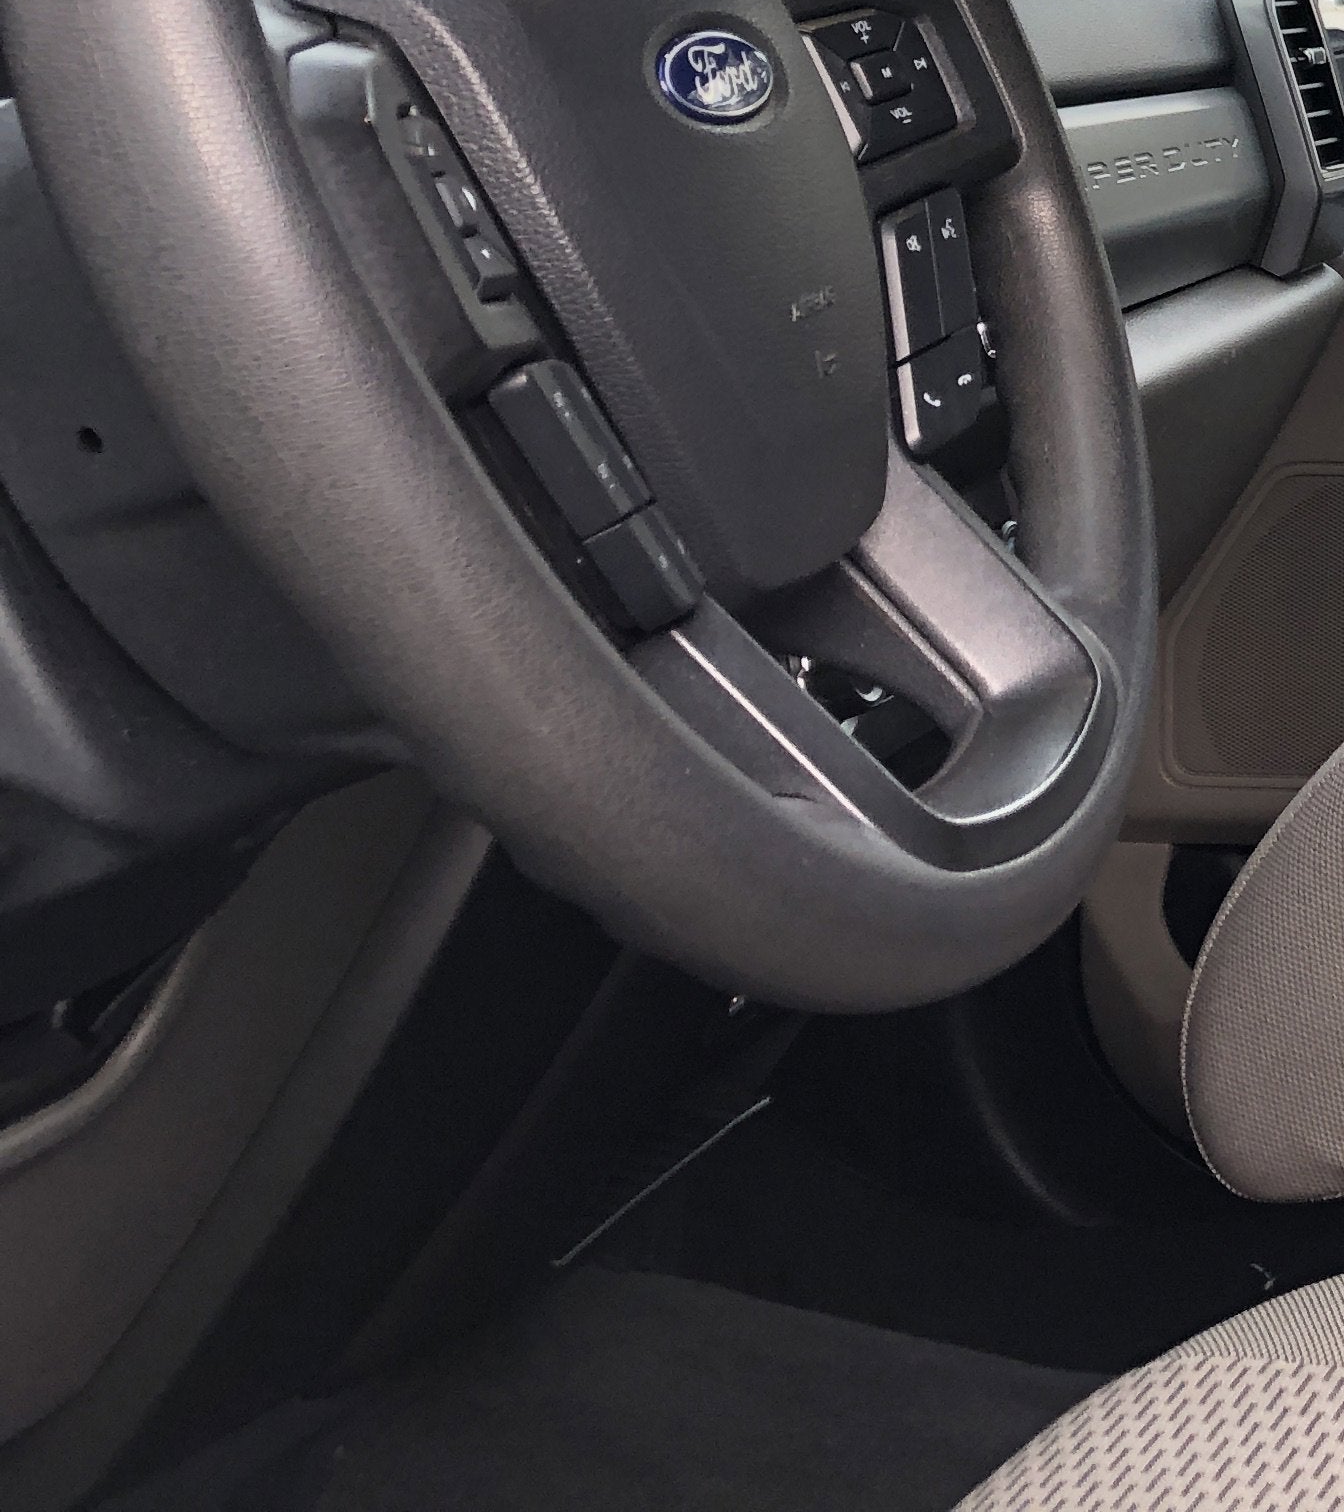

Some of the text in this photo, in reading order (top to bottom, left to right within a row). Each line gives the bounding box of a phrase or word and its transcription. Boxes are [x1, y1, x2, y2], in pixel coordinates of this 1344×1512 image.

[850, 20, 872, 34] VOL
[687, 42, 758, 107] Ford
[889, 106, 912, 119] VOL
[1080, 151, 1160, 190] PER
